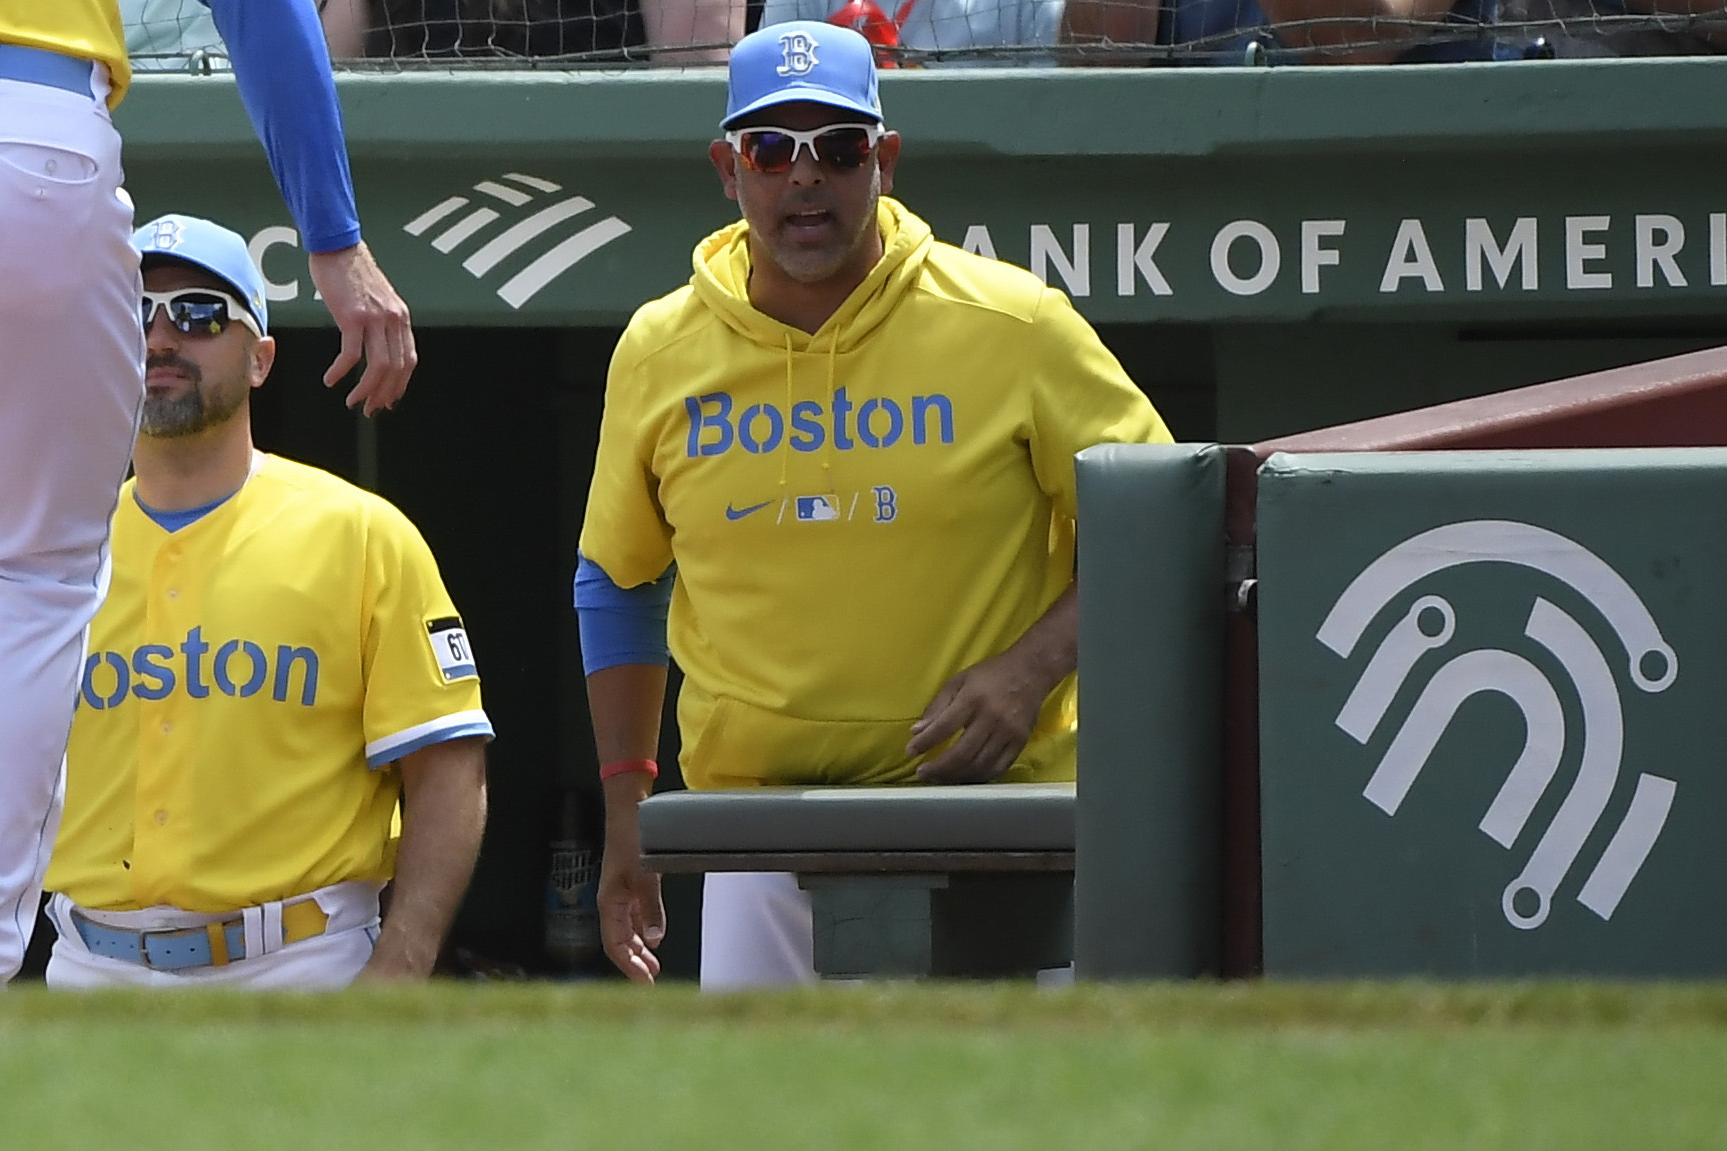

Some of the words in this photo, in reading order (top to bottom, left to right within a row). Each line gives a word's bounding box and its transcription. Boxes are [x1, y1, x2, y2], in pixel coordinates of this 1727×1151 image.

[776, 30, 820, 77] B
[962, 222, 1174, 297] ANK
[1210, 219, 1346, 295] OF
[1379, 212, 1727, 292] AMERI
[685, 386, 954, 458] Boston
[871, 485, 898, 523] B
[80, 625, 319, 710] oston
